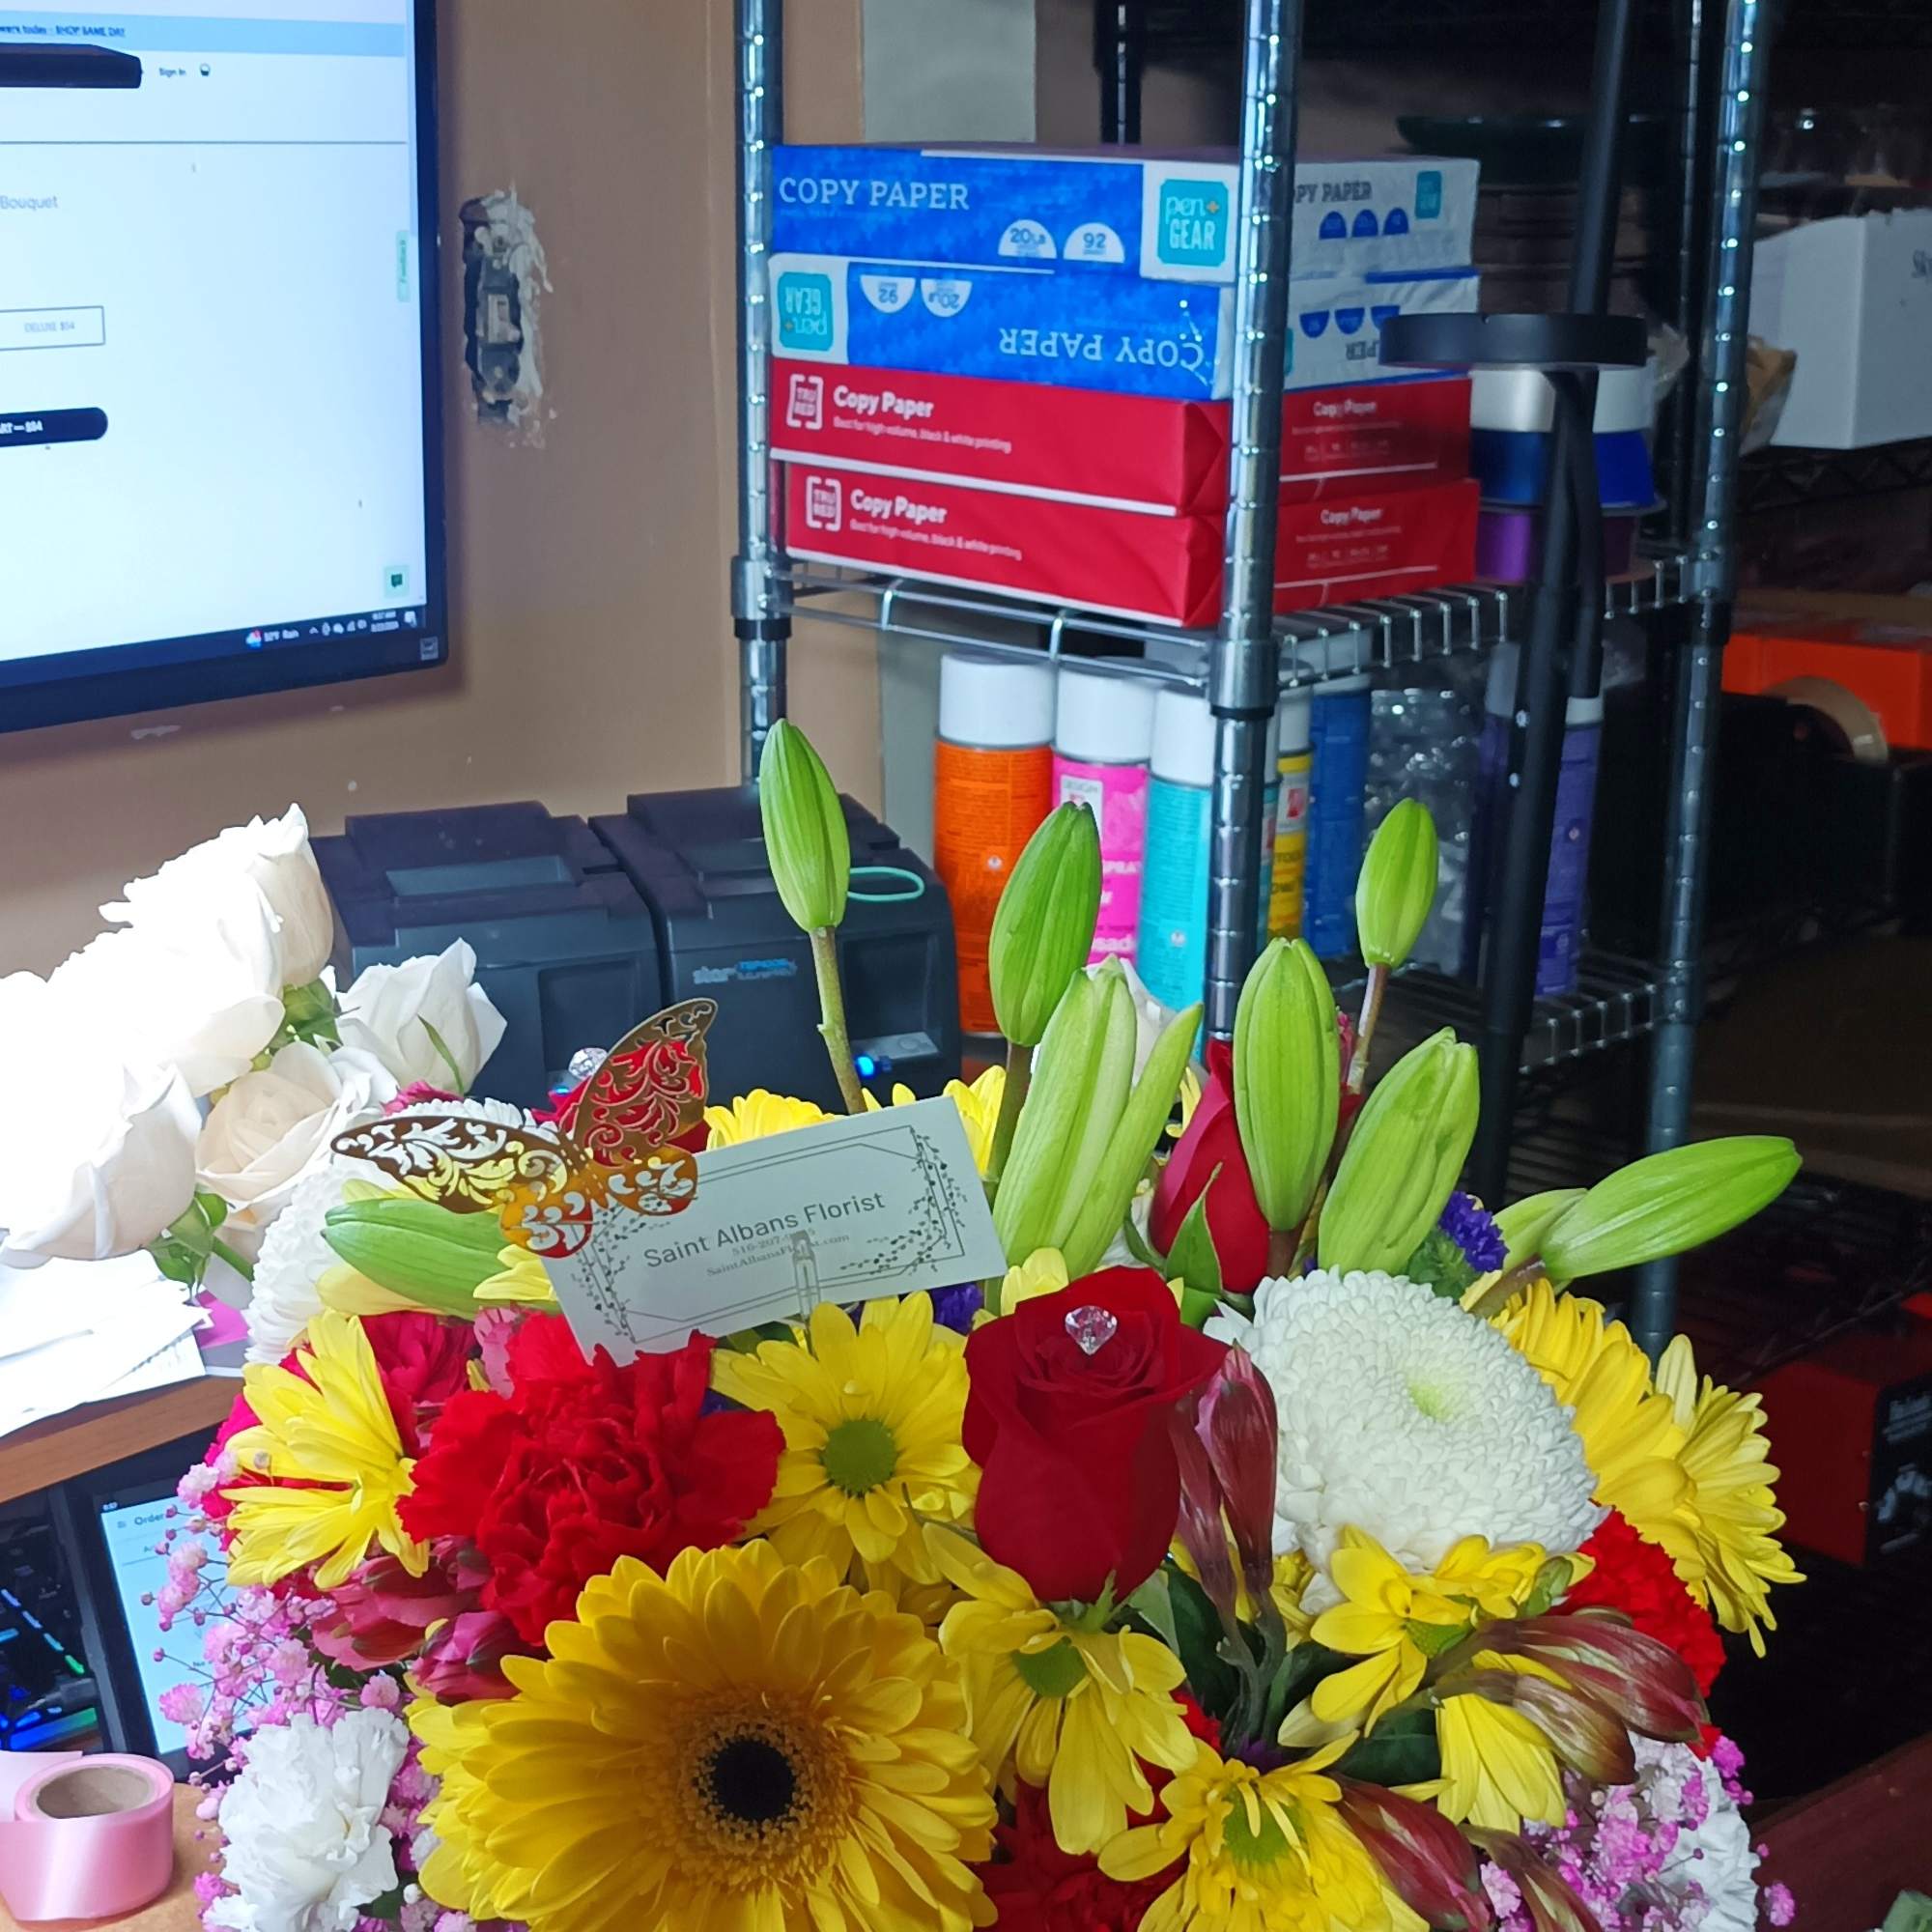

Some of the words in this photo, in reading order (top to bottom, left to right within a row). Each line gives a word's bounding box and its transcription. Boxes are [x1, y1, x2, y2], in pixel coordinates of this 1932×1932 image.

[159, 68, 177, 77] Sign
[0, 194, 58, 211] Bouquet
[779, 177, 860, 206] COPY
[869, 181, 970, 211] PAPER
[1321, 181, 1373, 202] PAPER
[1165, 196, 1207, 224] pen
[1083, 233, 1106, 249] 92
[1169, 219, 1216, 251] GEAR
[784, 286, 821, 316] GEAR
[878, 287, 898, 304] 92
[999, 328, 1104, 361] PAPER
[1115, 336, 1206, 371] COPY
[833, 385, 879, 416] Copy
[881, 390, 934, 420] Paper
[1313, 401, 1342, 417] Copy
[1344, 399, 1378, 415] Paper
[850, 489, 894, 520] Copy
[895, 496, 948, 526] Paper
[1320, 509, 1350, 526] Copy
[1350, 506, 1382, 524] Paper
[643, 1236, 711, 1268] Saint
[717, 1213, 799, 1247] Albans
[804, 1192, 886, 1224] Florist
